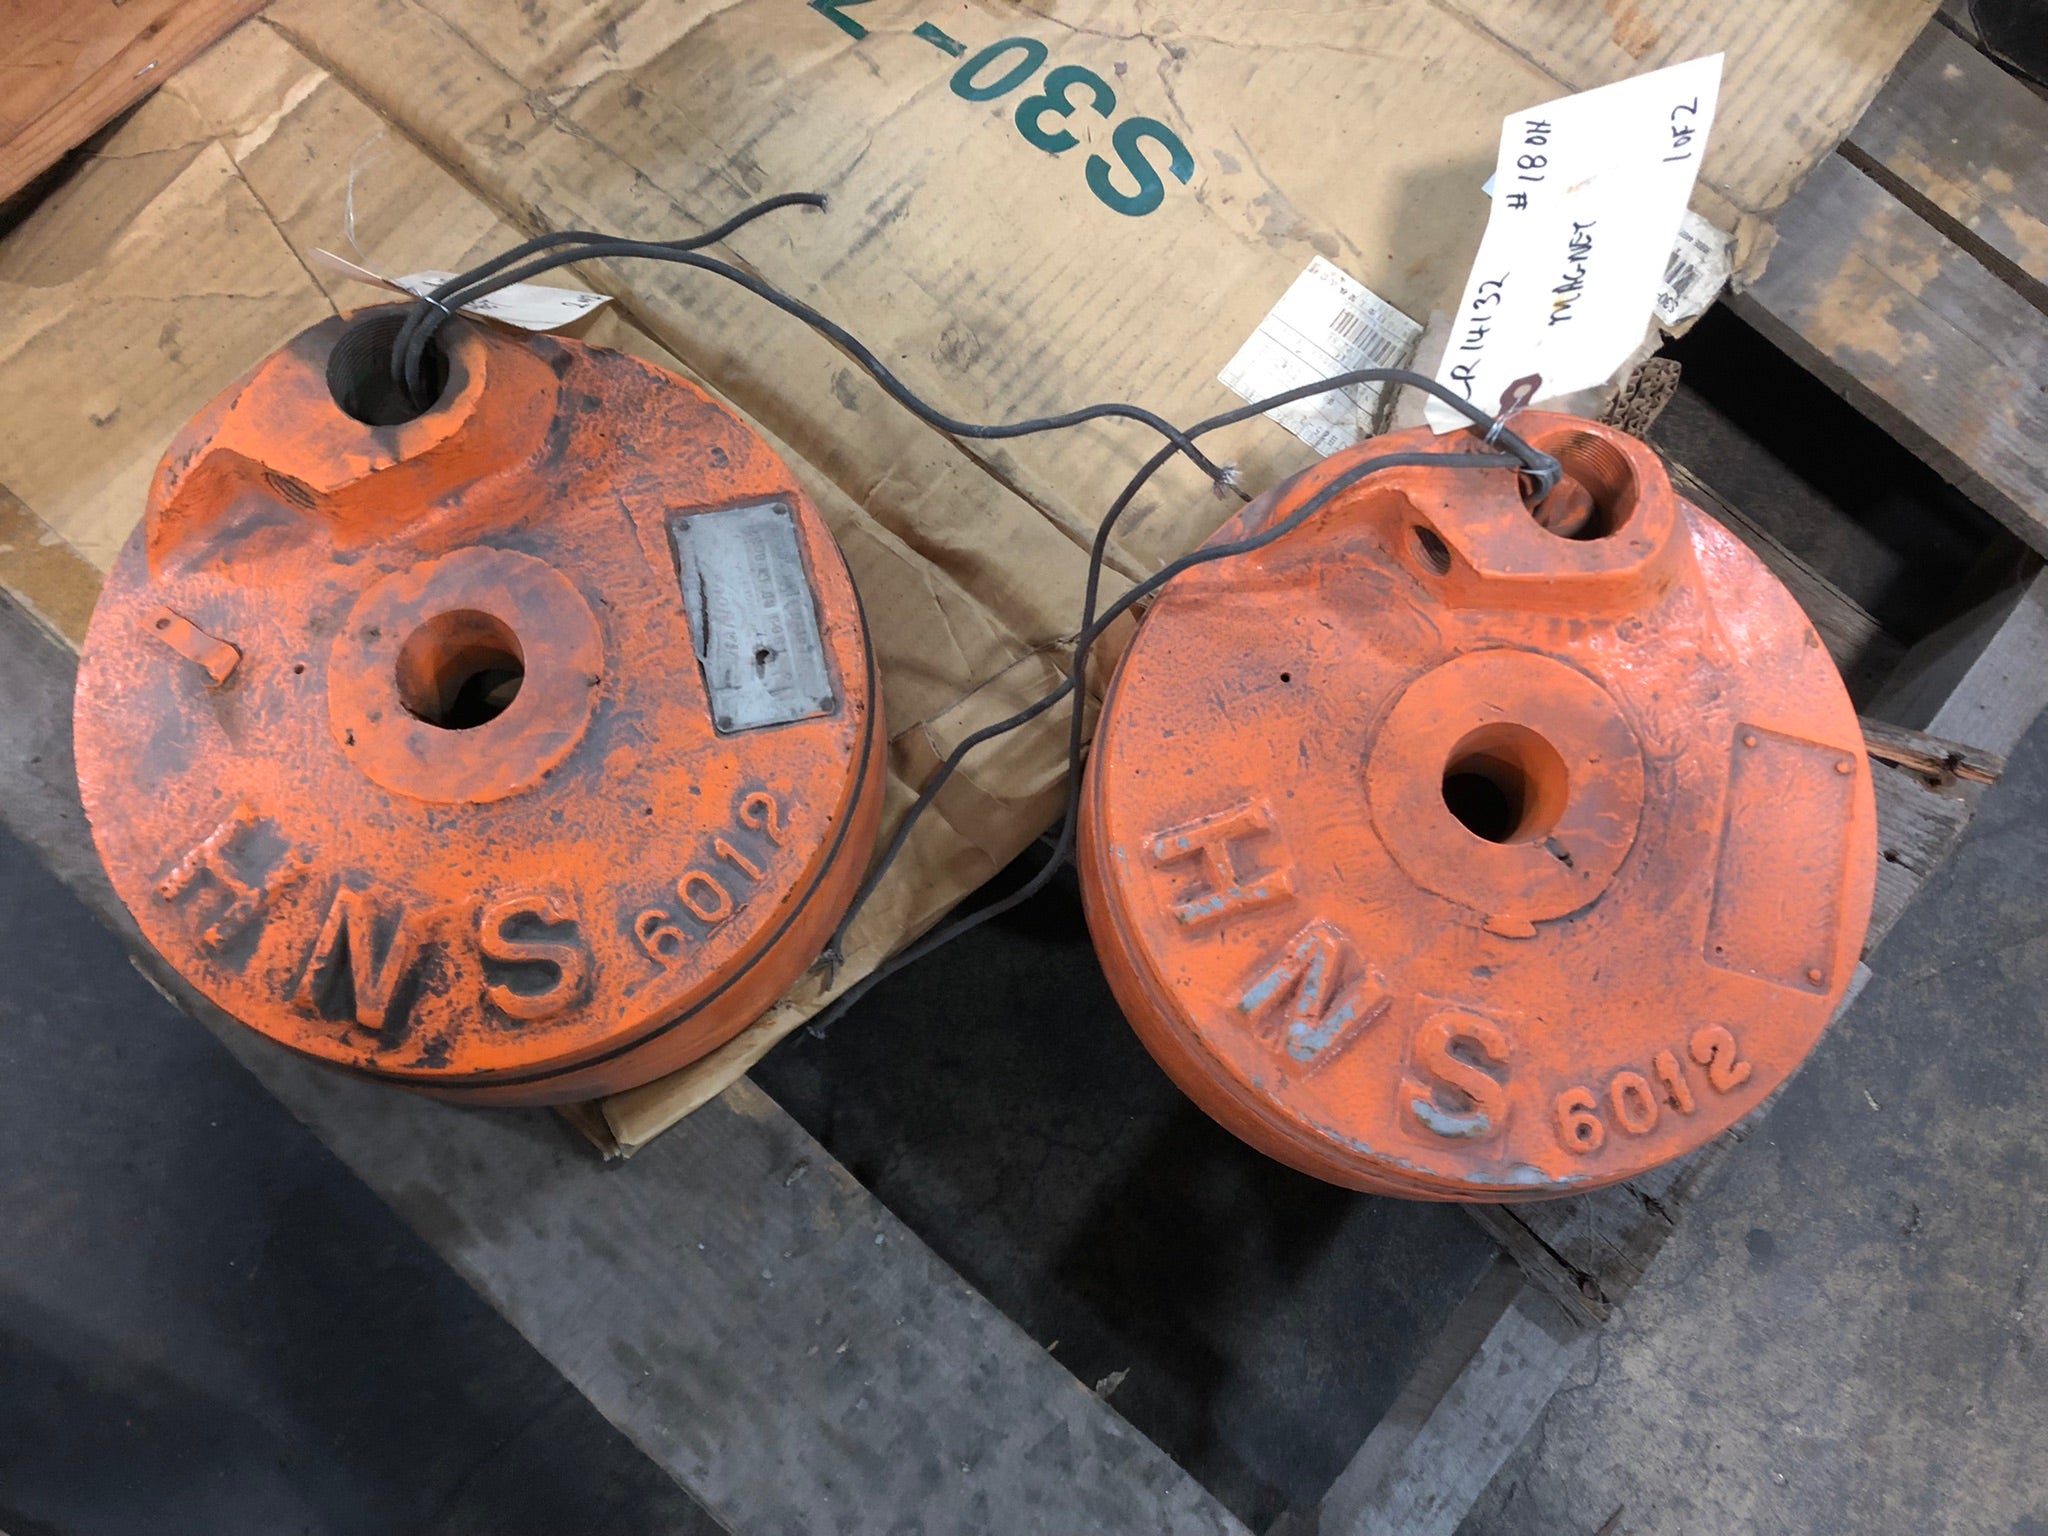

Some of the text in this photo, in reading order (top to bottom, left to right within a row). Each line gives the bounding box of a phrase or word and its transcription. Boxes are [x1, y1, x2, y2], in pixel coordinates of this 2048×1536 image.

[1548, 220, 1597, 326] MAGNET
[632, 789, 790, 974] 6012
[1143, 797, 1752, 1155] HNS 6012
